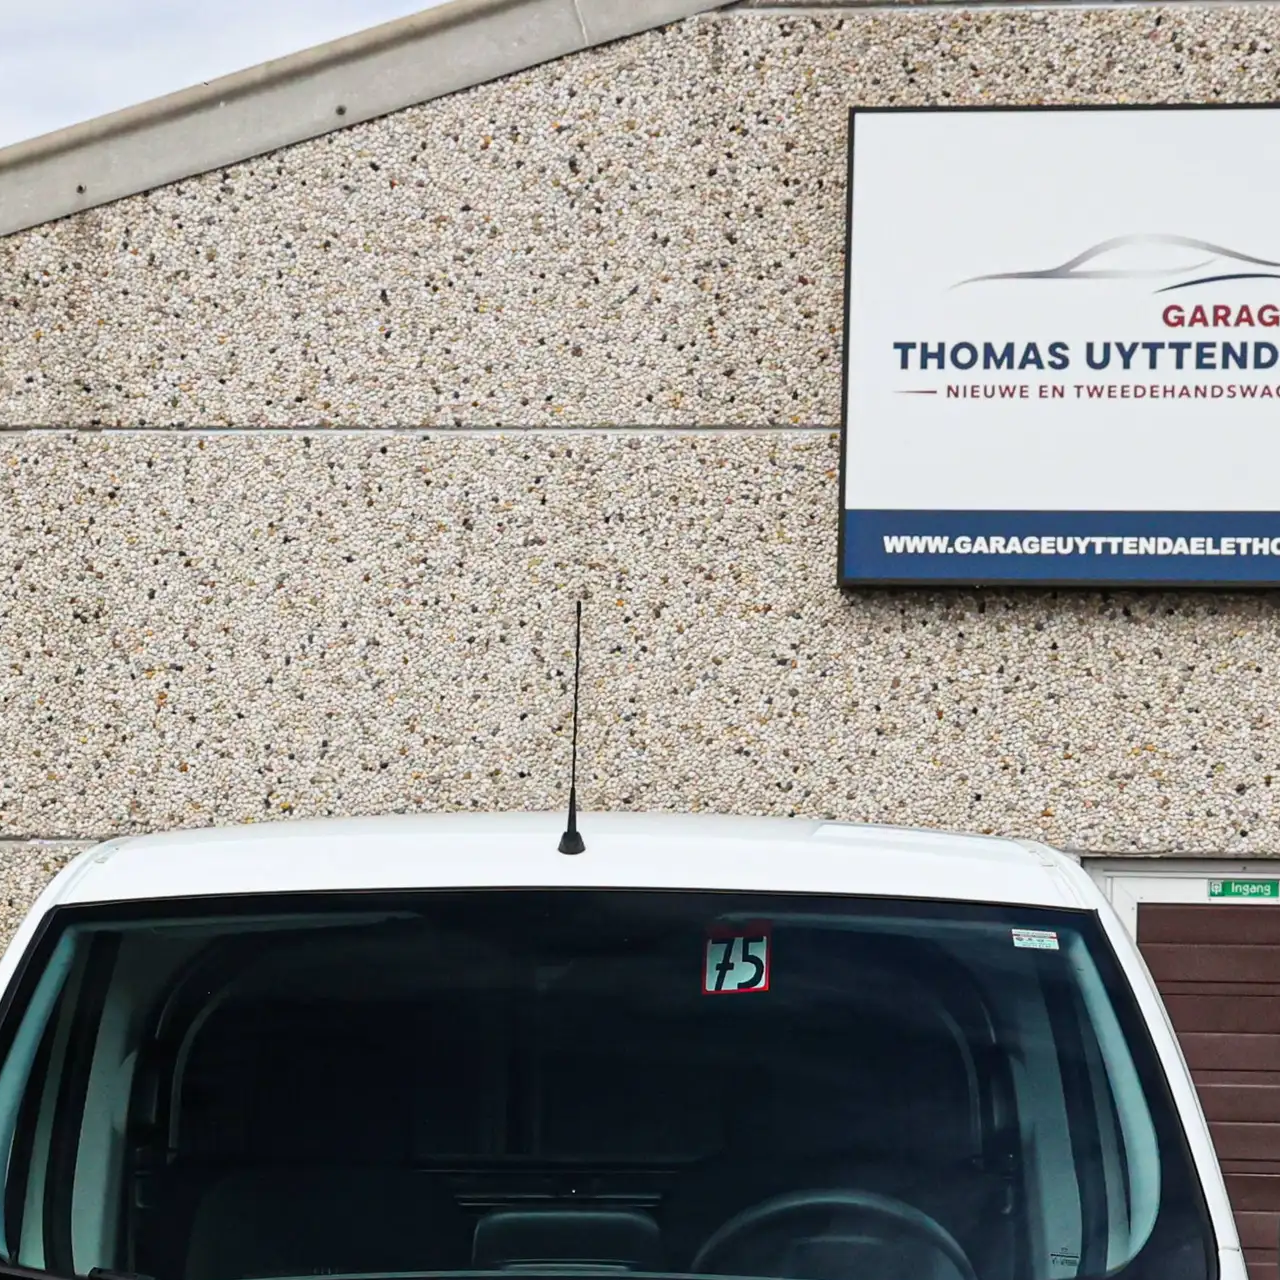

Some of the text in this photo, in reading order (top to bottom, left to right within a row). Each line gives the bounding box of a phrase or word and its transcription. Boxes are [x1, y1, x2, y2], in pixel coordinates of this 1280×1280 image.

[892, 341, 1070, 371] THOMAS
[946, 384, 1030, 400] NIEUWE
[1038, 384, 1065, 400] EN
[1231, 881, 1272, 896] Ingang
[711, 937, 765, 991] 75
